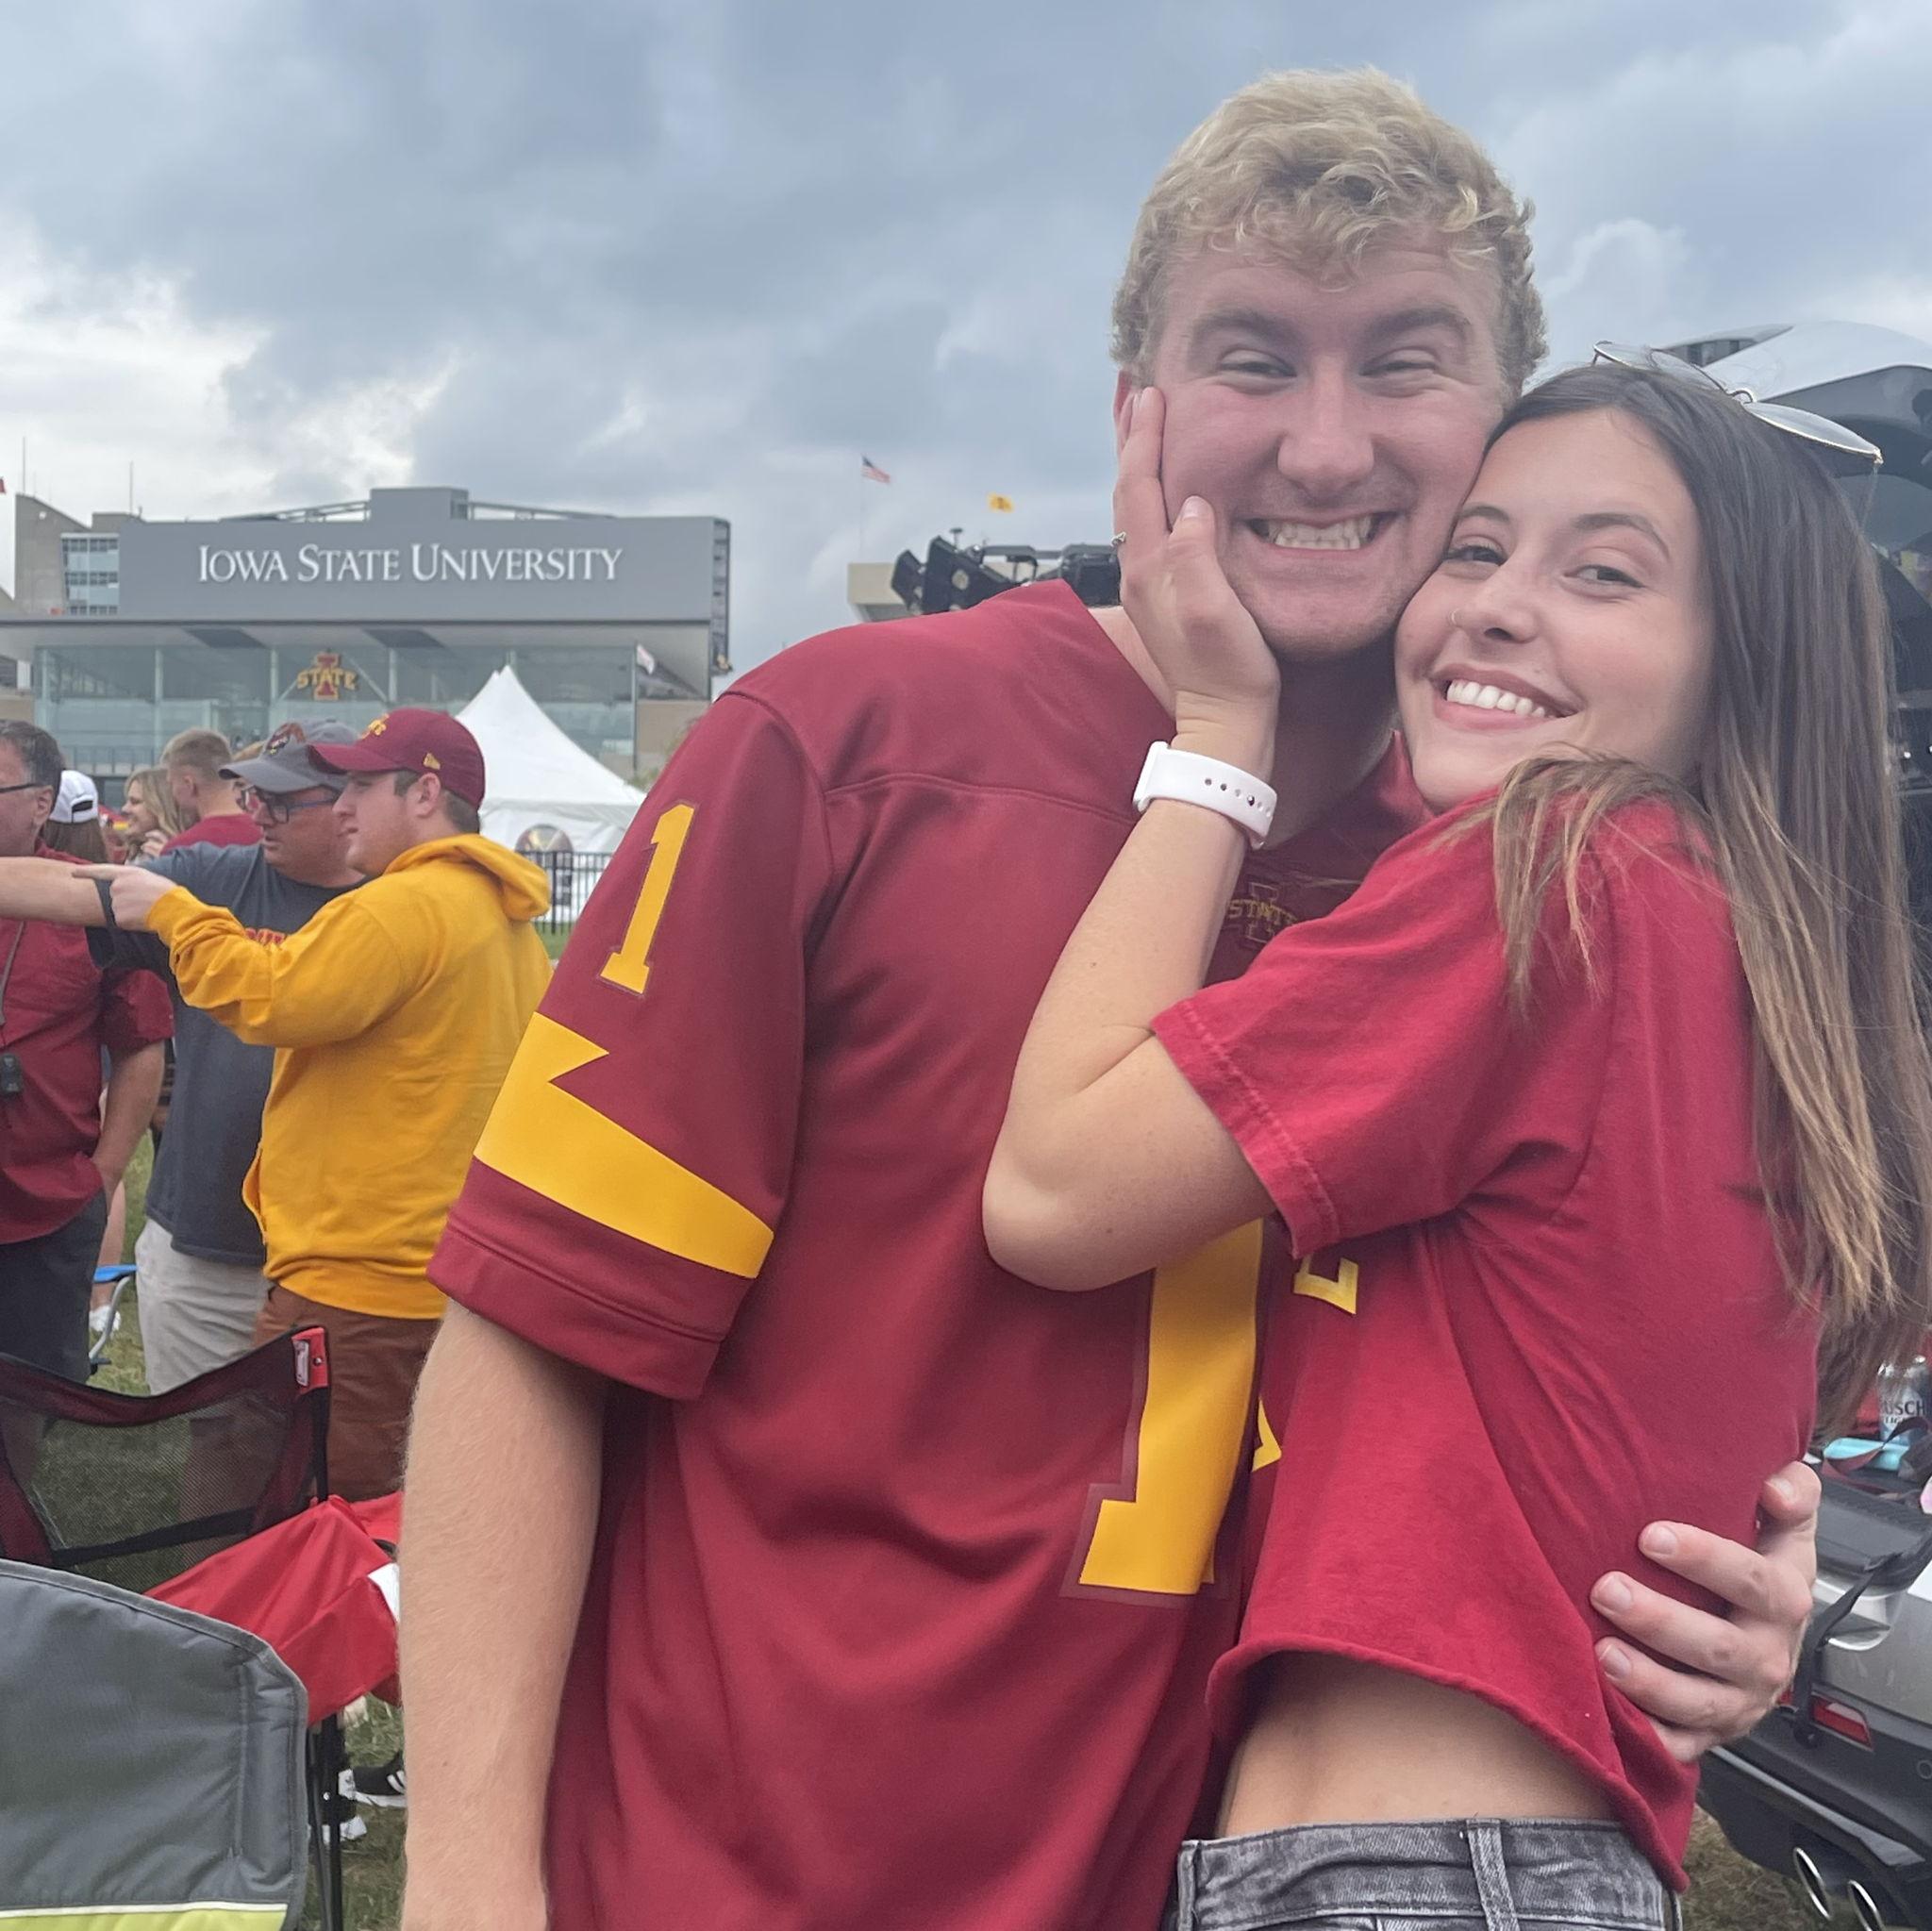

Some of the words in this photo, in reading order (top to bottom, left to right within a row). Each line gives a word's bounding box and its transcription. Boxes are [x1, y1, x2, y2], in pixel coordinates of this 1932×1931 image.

[198, 544, 290, 583] IOWA
[297, 543, 401, 583] STATE
[410, 543, 623, 582] UNIVERSITY
[598, 803, 695, 995] 1
